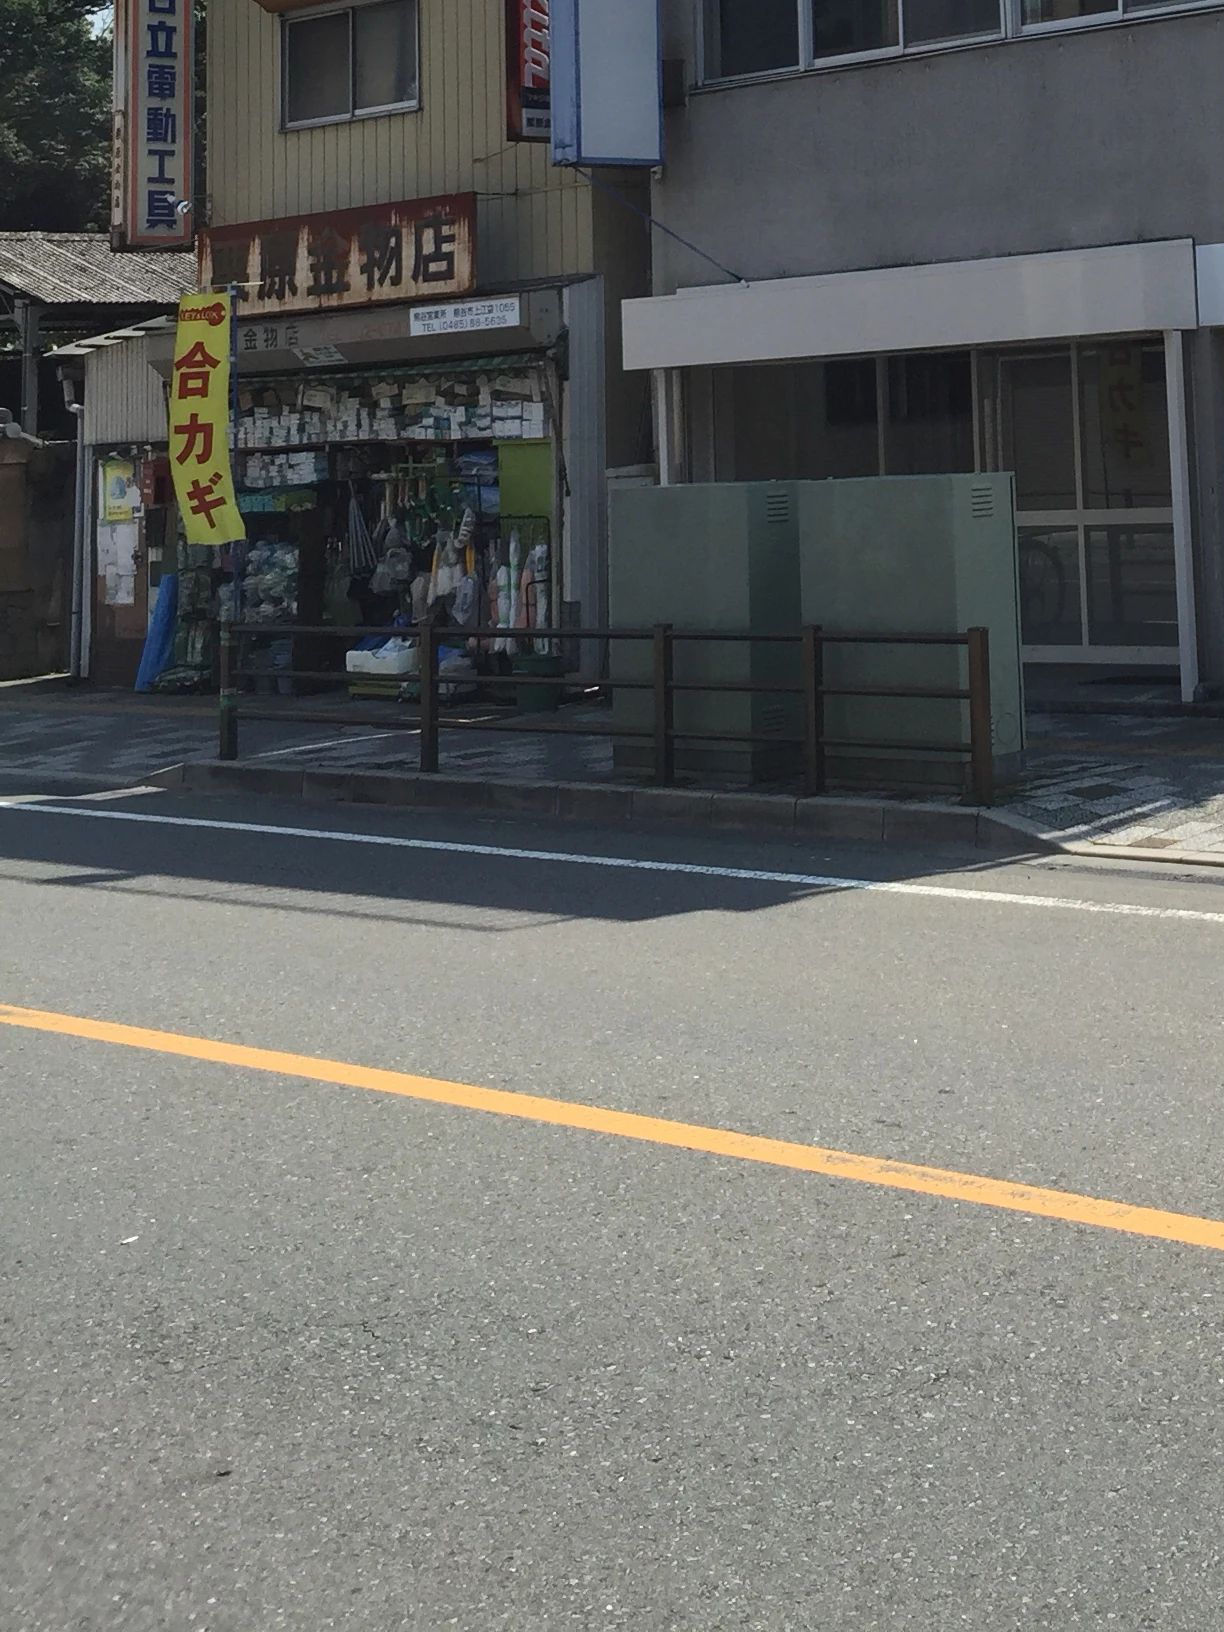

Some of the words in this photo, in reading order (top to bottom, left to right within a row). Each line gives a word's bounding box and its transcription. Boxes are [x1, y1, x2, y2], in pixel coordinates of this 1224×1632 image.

[422, 323, 437, 332] TEL
[174, 341, 227, 529] 合カギ
